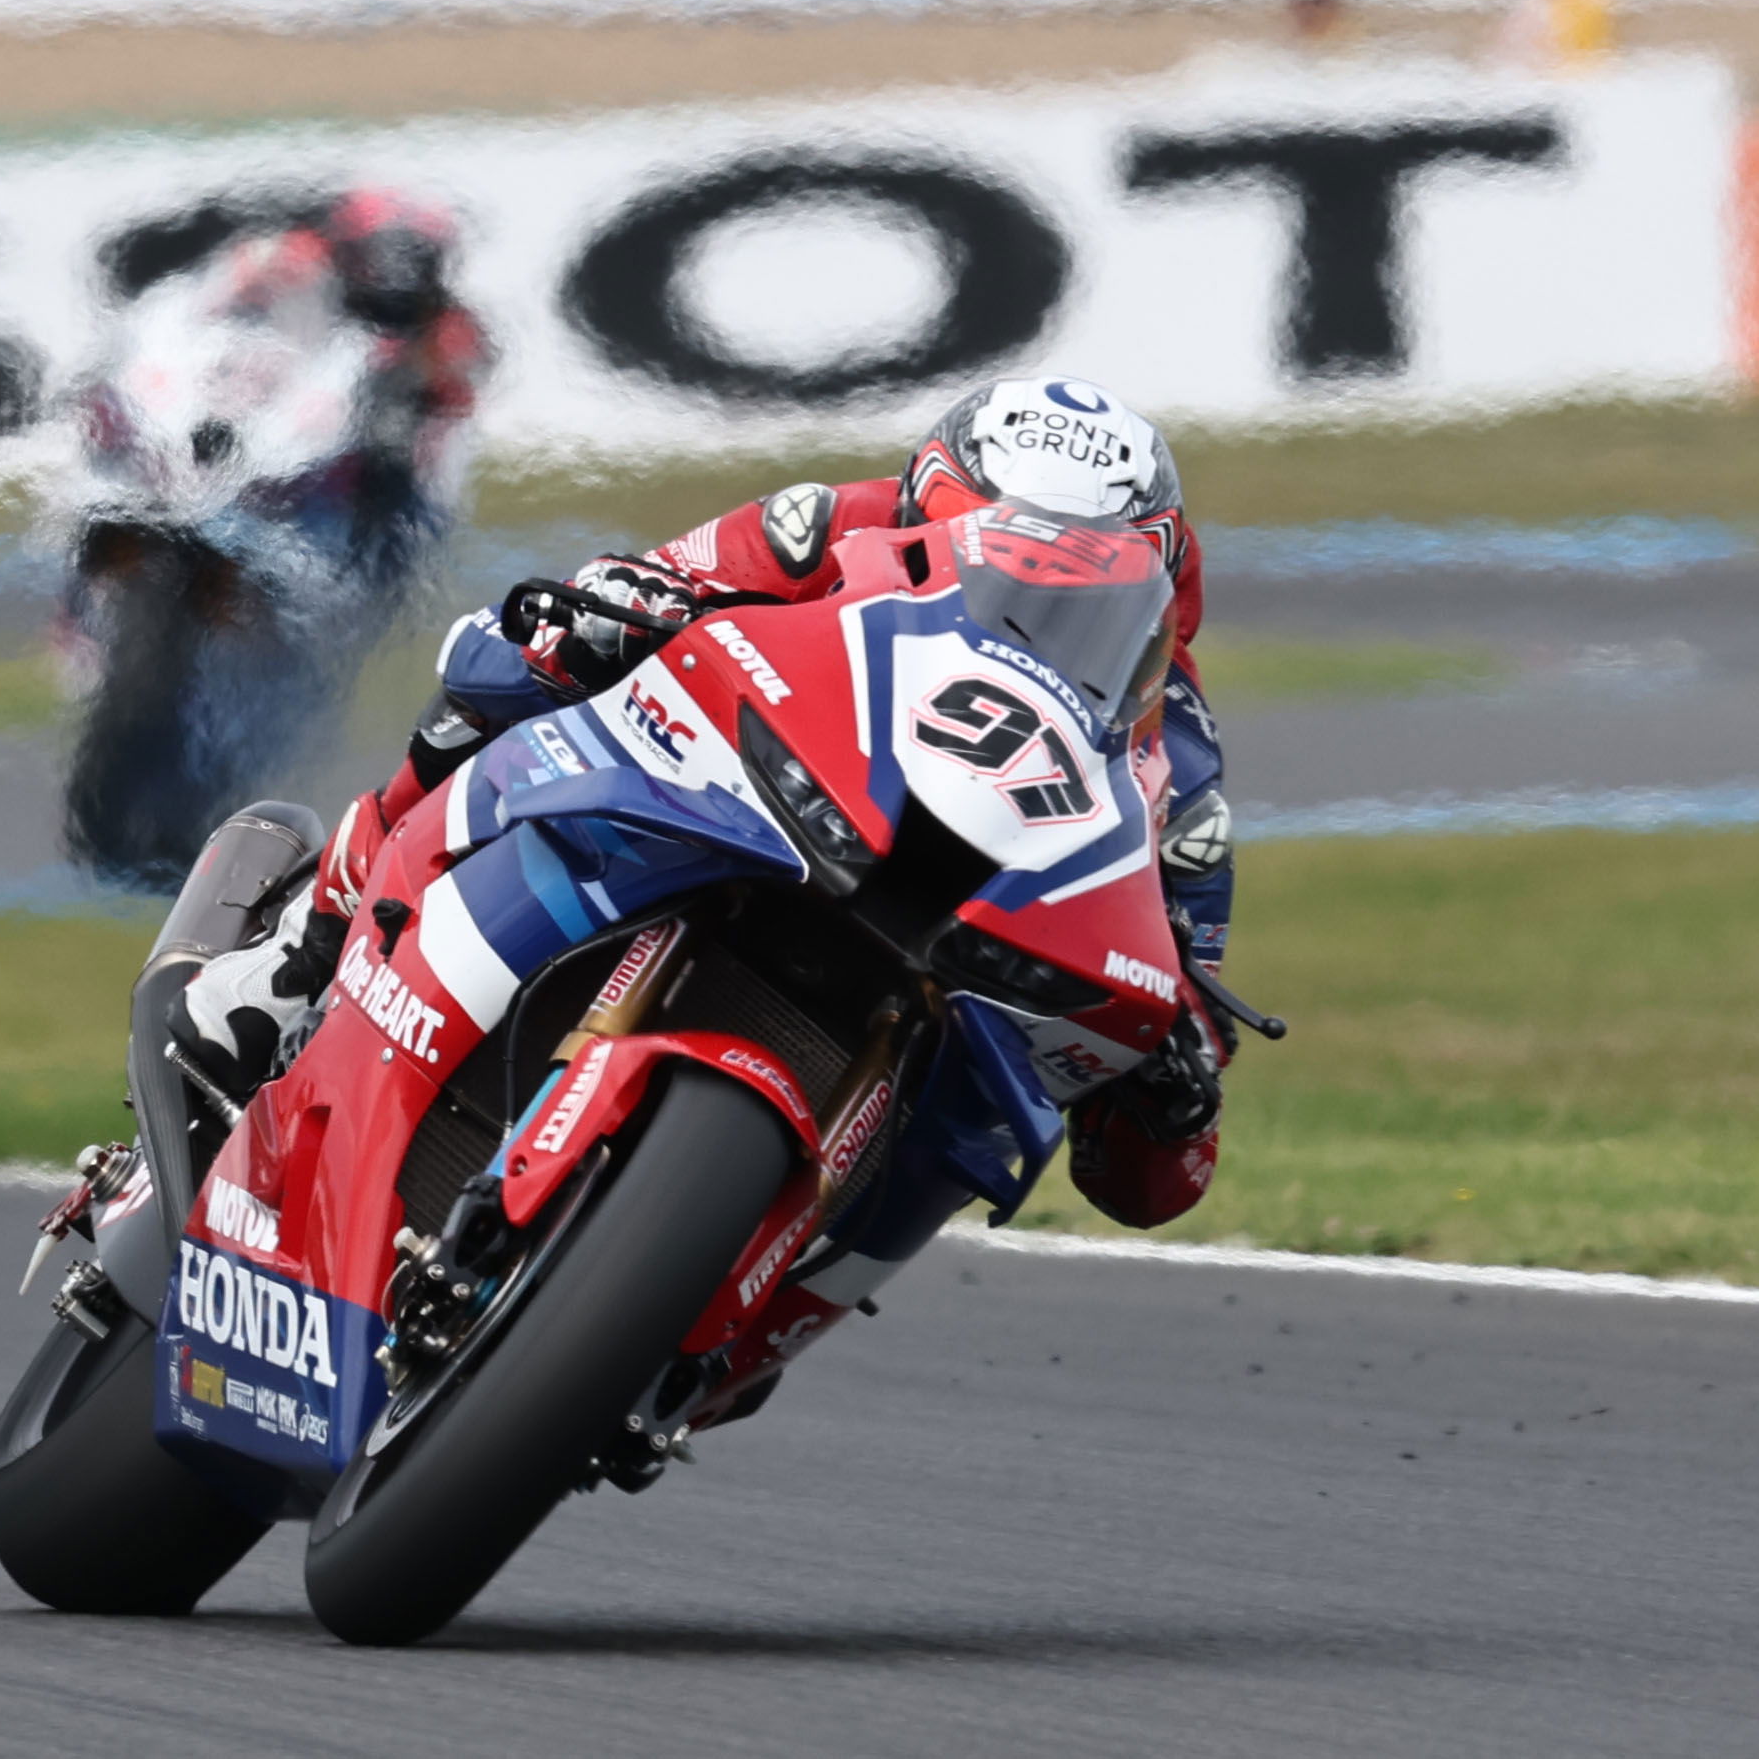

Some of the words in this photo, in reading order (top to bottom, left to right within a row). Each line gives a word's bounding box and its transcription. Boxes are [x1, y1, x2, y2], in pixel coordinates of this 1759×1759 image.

[1015, 428, 1113, 469] GRUP
[1017, 409, 1121, 449] PONT
[703, 619, 793, 706] MOTUL
[976, 639, 1094, 739] HONDA
[624, 678, 698, 764] HRC
[913, 677, 1097, 821] 97
[337, 934, 373, 1000] One
[360, 962, 446, 1064] HEART.
[1103, 949, 1178, 1005] MOTUL
[533, 1041, 614, 1155] PIRELLI
[831, 1080, 894, 1177] SHOWA
[205, 1175, 280, 1253] MOTUL
[178, 1239, 338, 1389] HONDA
